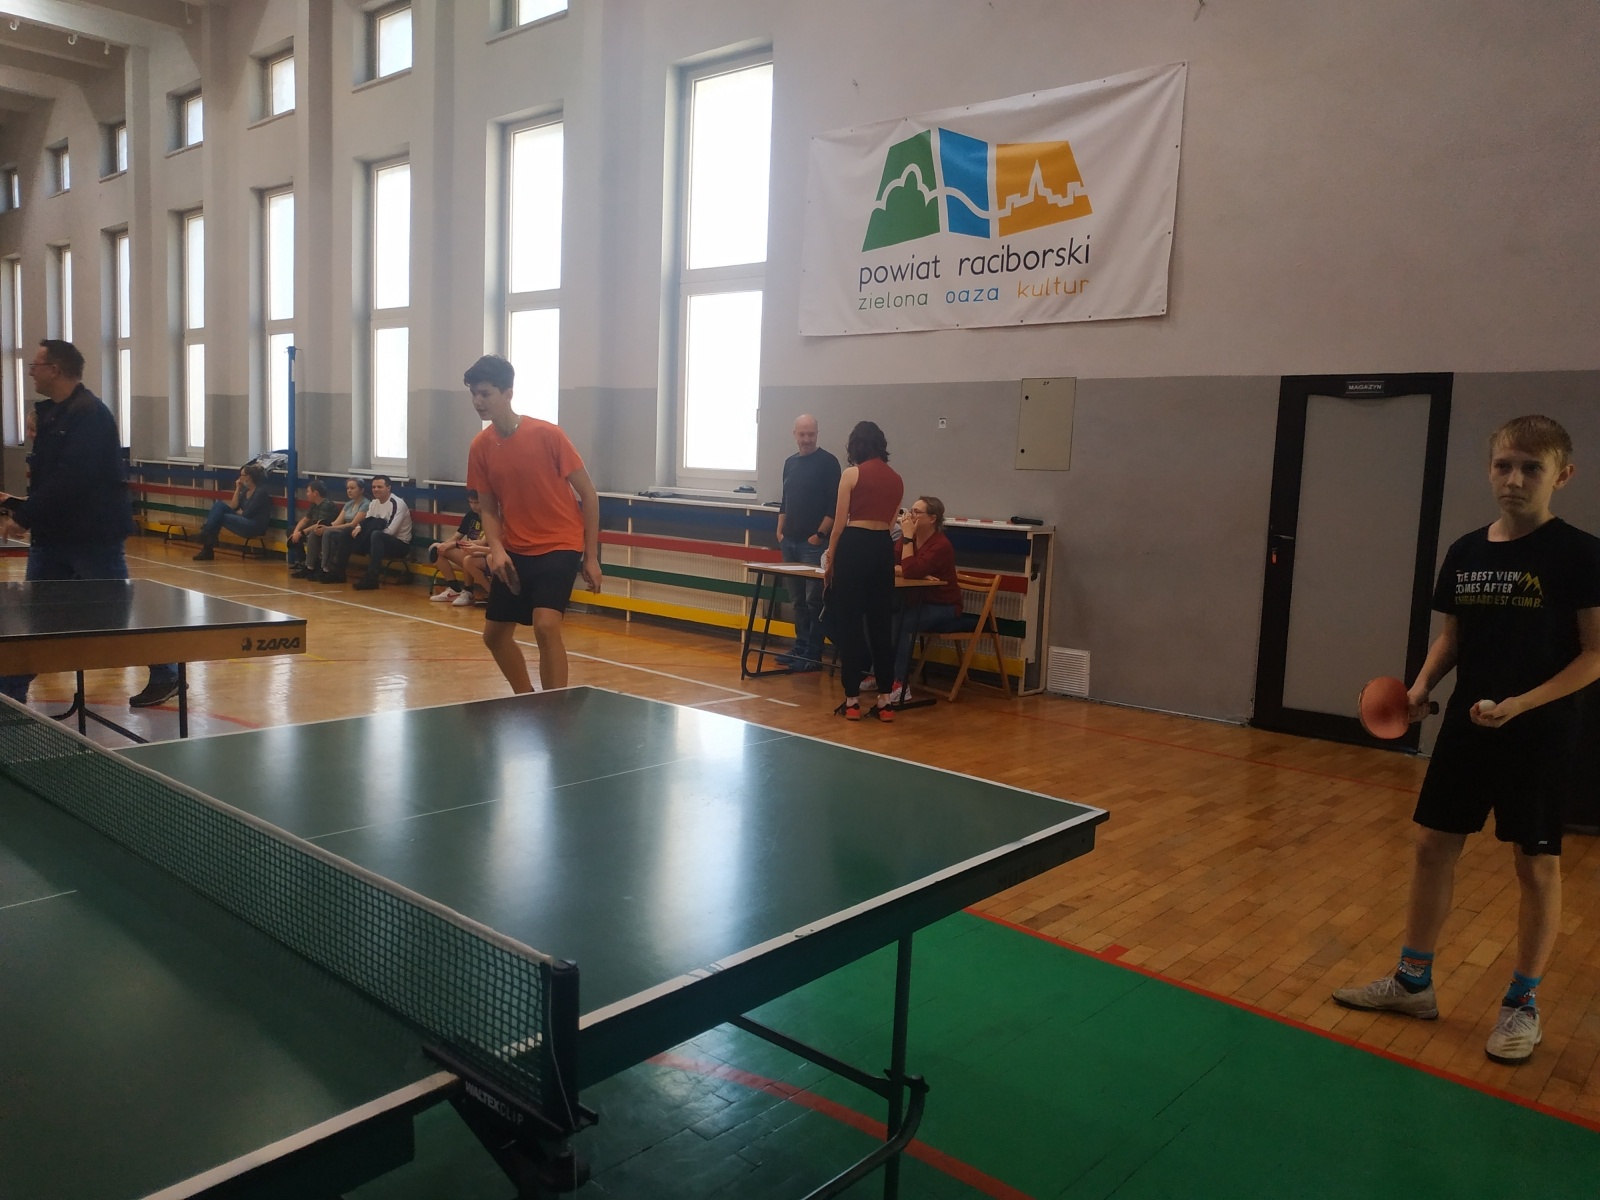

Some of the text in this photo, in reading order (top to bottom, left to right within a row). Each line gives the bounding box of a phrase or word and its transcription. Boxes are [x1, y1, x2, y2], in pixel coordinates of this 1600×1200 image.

[859, 234, 1091, 292] powiat raciborski
[858, 276, 1090, 310] zielona oaza kultur
[1470, 571, 1494, 582] BEST
[1496, 571, 1522, 582] VIEW
[1455, 582, 1513, 594] COMES AFTER
[256, 637, 300, 651] ZARA
